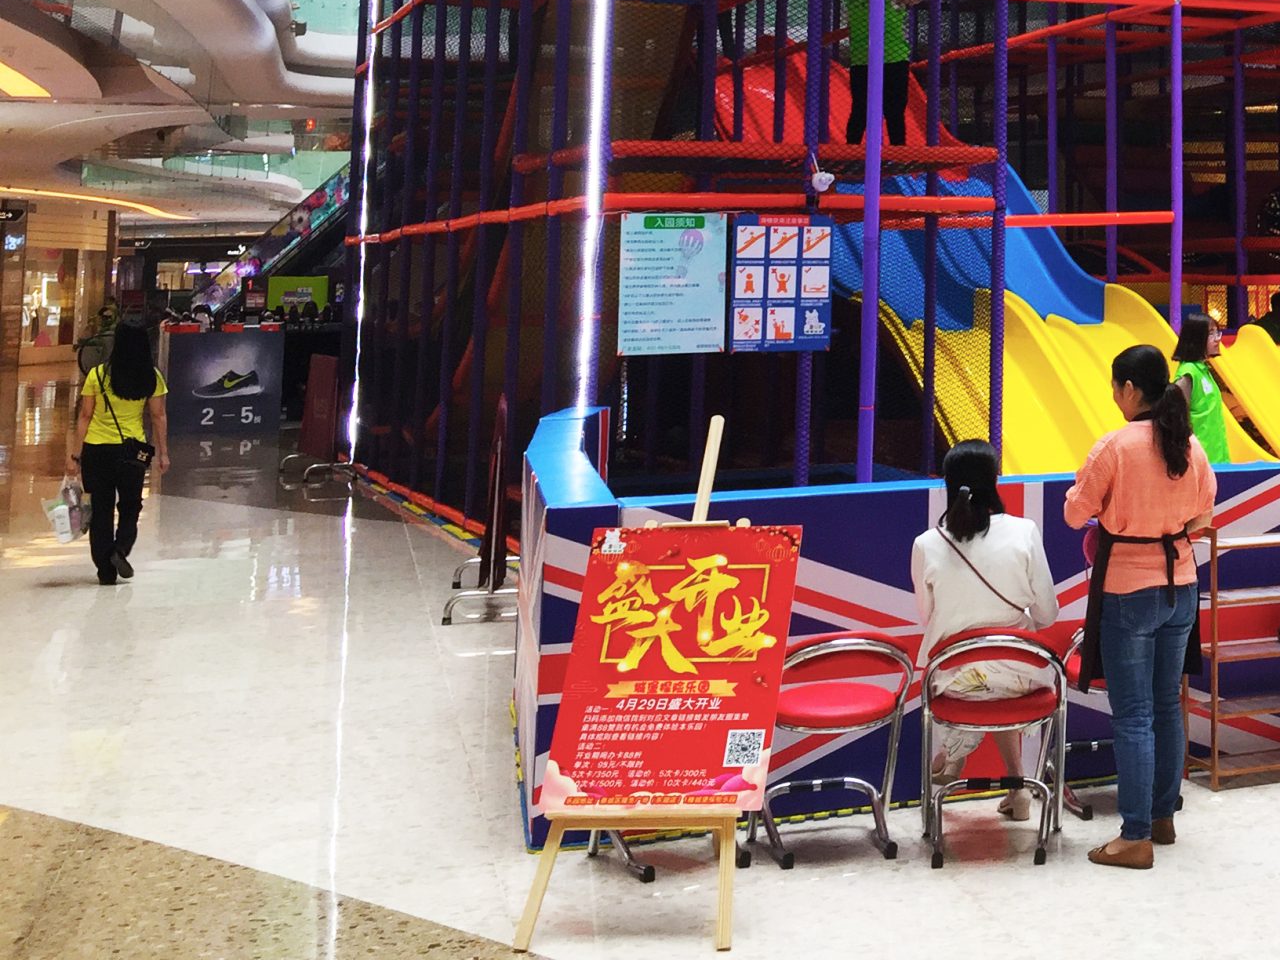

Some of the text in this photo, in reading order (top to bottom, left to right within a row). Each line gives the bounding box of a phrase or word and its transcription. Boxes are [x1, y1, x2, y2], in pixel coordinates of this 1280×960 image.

[615, 697, 722, 711] 4月29日盛大开业
